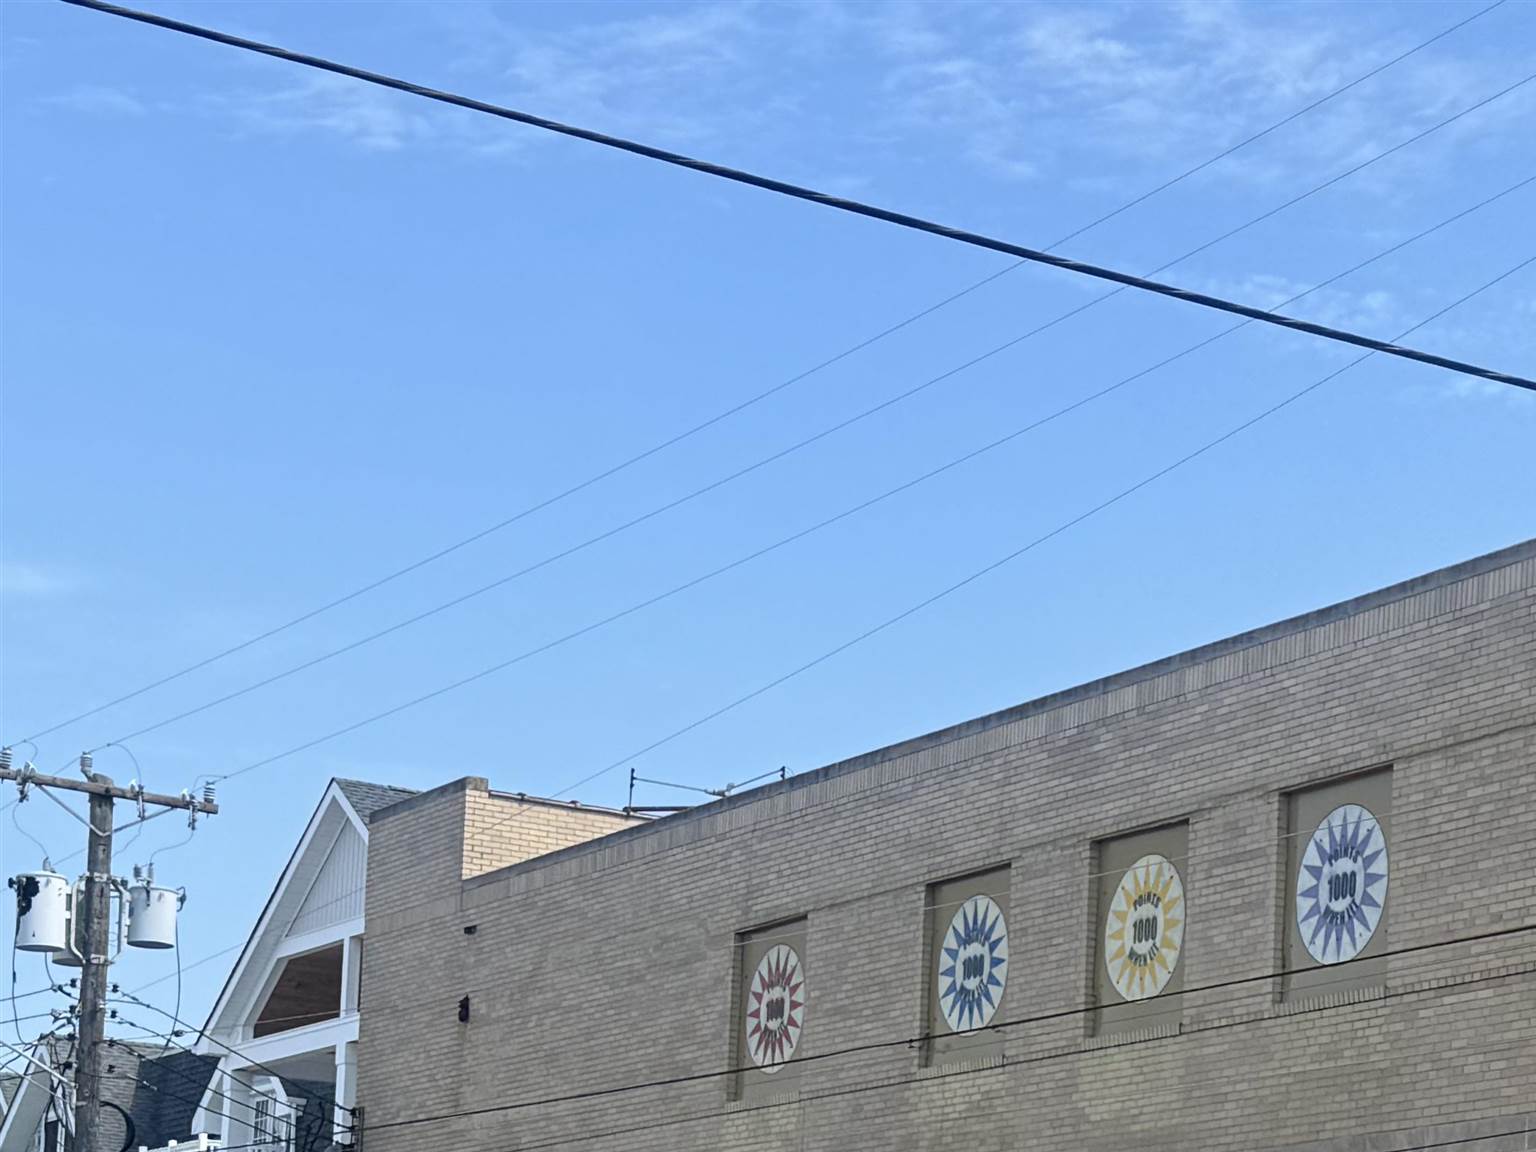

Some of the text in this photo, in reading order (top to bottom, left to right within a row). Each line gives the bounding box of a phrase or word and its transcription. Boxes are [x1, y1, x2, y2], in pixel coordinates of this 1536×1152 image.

[1328, 845, 1361, 867] POINTS
[1327, 870, 1357, 903] 1000
[1132, 915, 1158, 945] 1000
[962, 953, 985, 982] 1000
